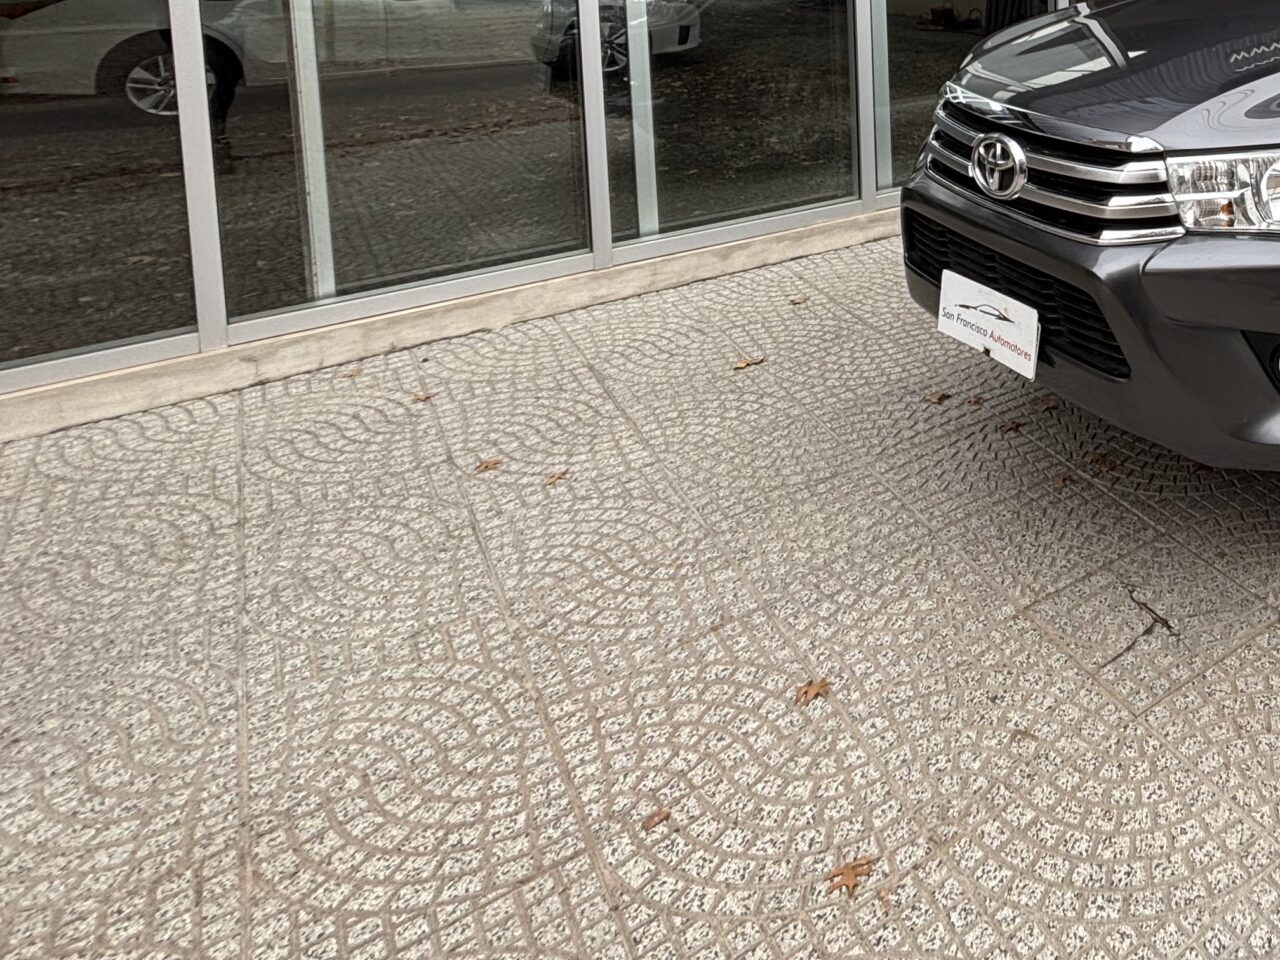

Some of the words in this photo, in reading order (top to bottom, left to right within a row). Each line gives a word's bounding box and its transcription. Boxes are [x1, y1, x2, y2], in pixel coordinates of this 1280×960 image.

[941, 306, 955, 322] San
[956, 313, 988, 337] Francisco
[989, 330, 1032, 362] Automotores
